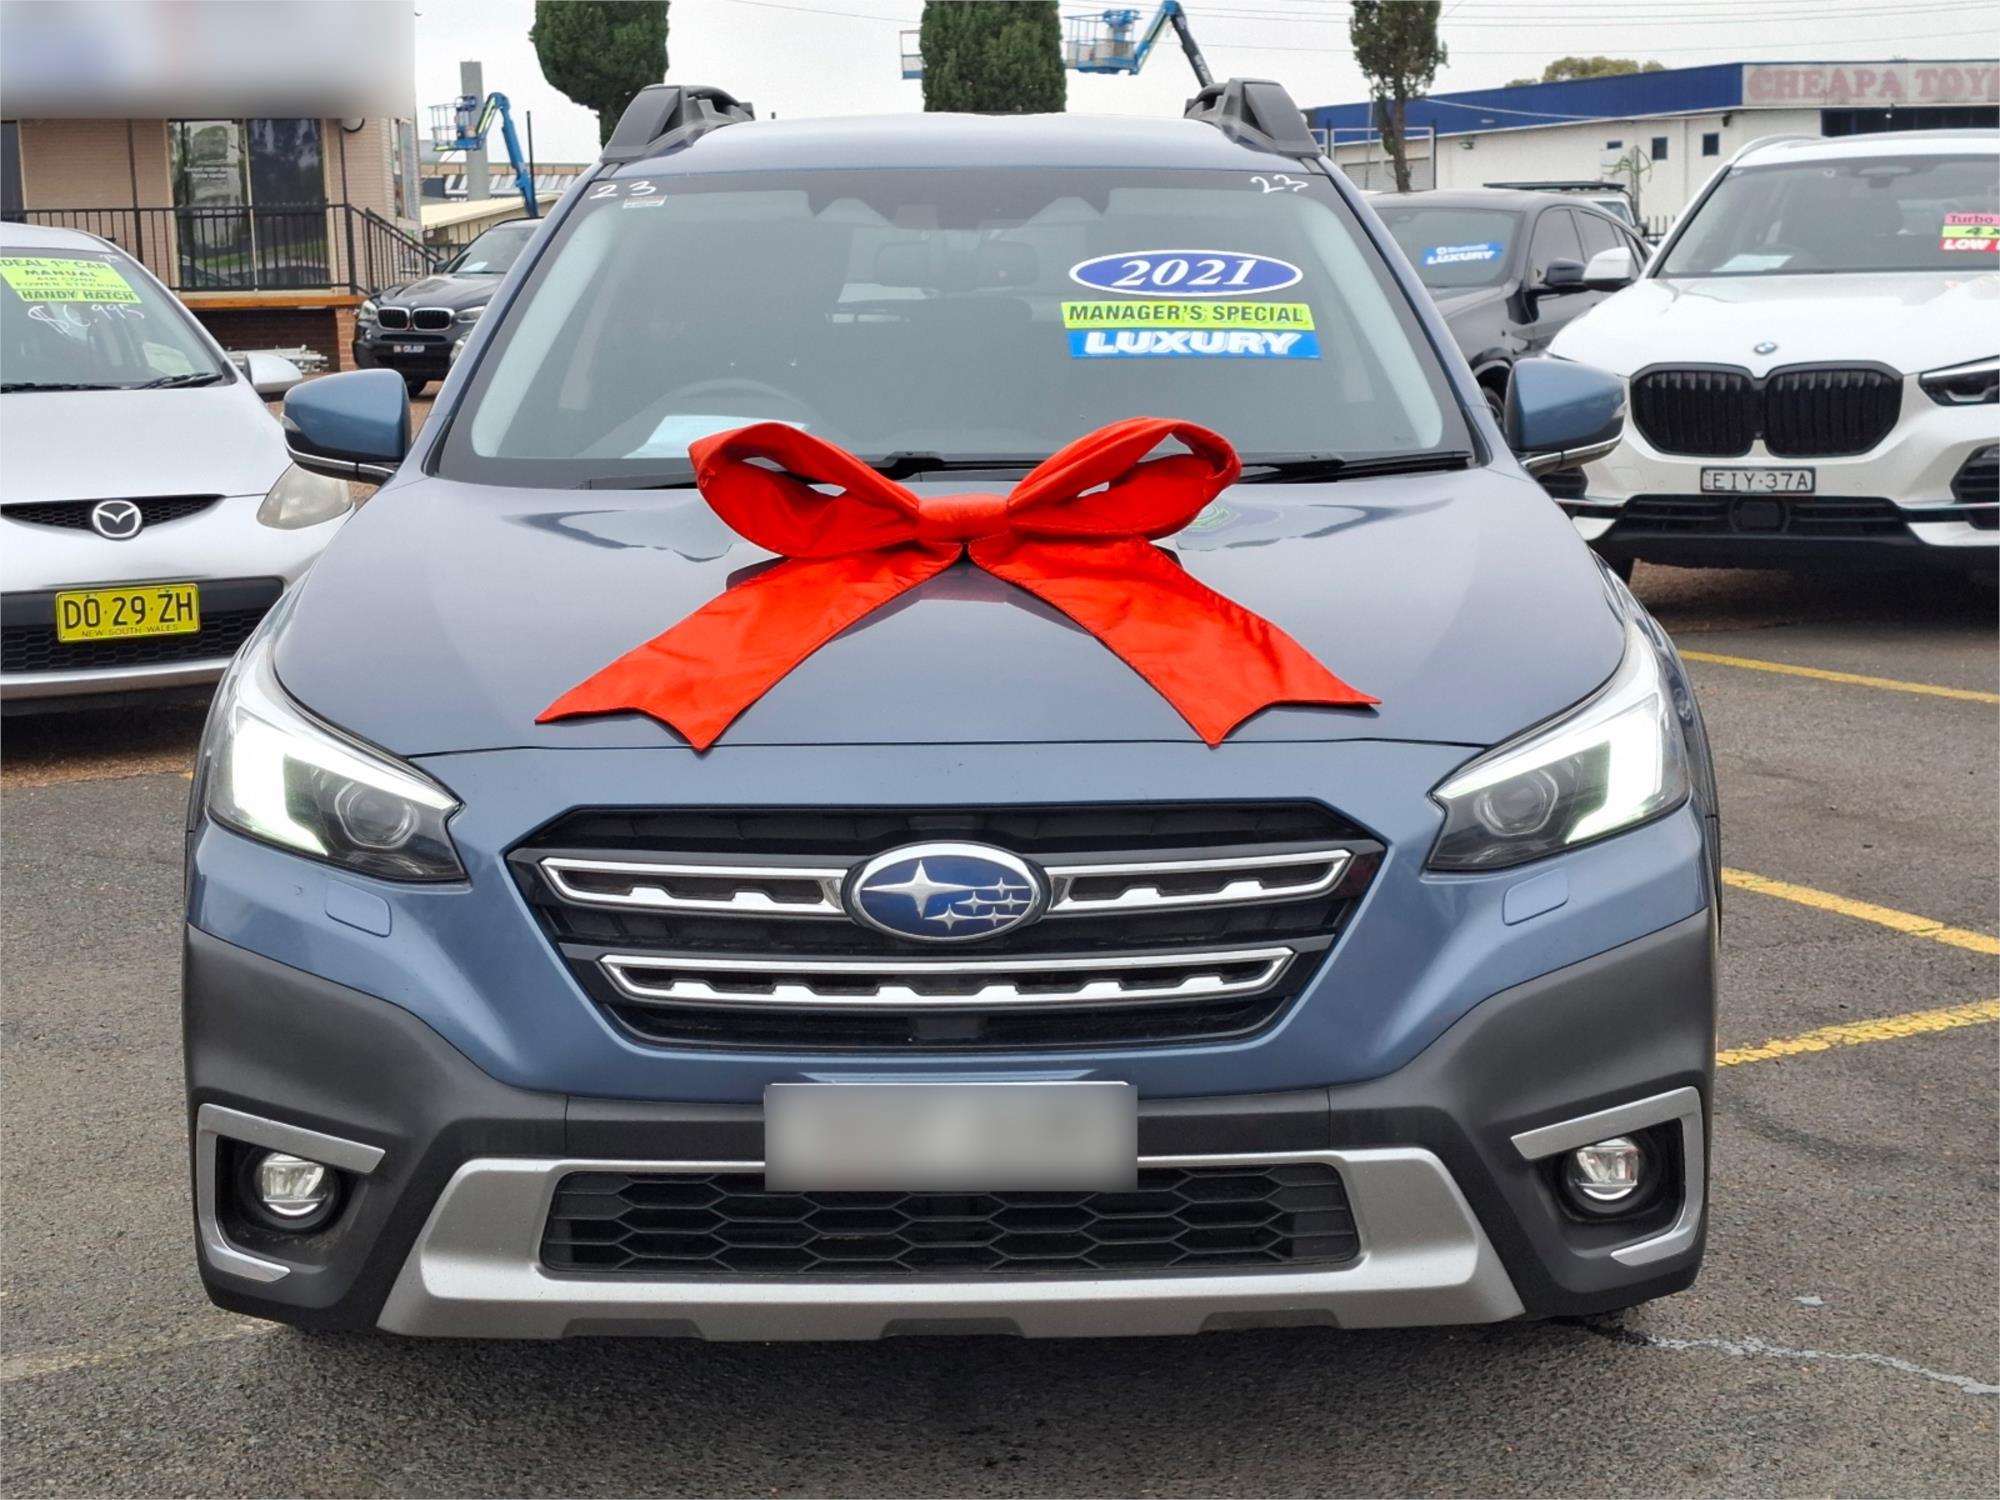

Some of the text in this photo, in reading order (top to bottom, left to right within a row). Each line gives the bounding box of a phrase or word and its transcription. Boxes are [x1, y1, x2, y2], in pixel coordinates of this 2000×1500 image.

[1746, 68, 1904, 99] CHEAPA
[1951, 215, 1993, 224] Turbo
[1943, 238, 1990, 250] LOW
[1426, 250, 1496, 265] LUXURY
[24, 269, 99, 277] MANUAL
[1110, 258, 1258, 287] 2021
[21, 290, 137, 301] HANDY HATCH
[1068, 304, 1304, 323] MANAGER'S SPECIAL
[1083, 330, 1303, 356] LUXURY
[81, 624, 179, 638] NEW SOUTH WALES
